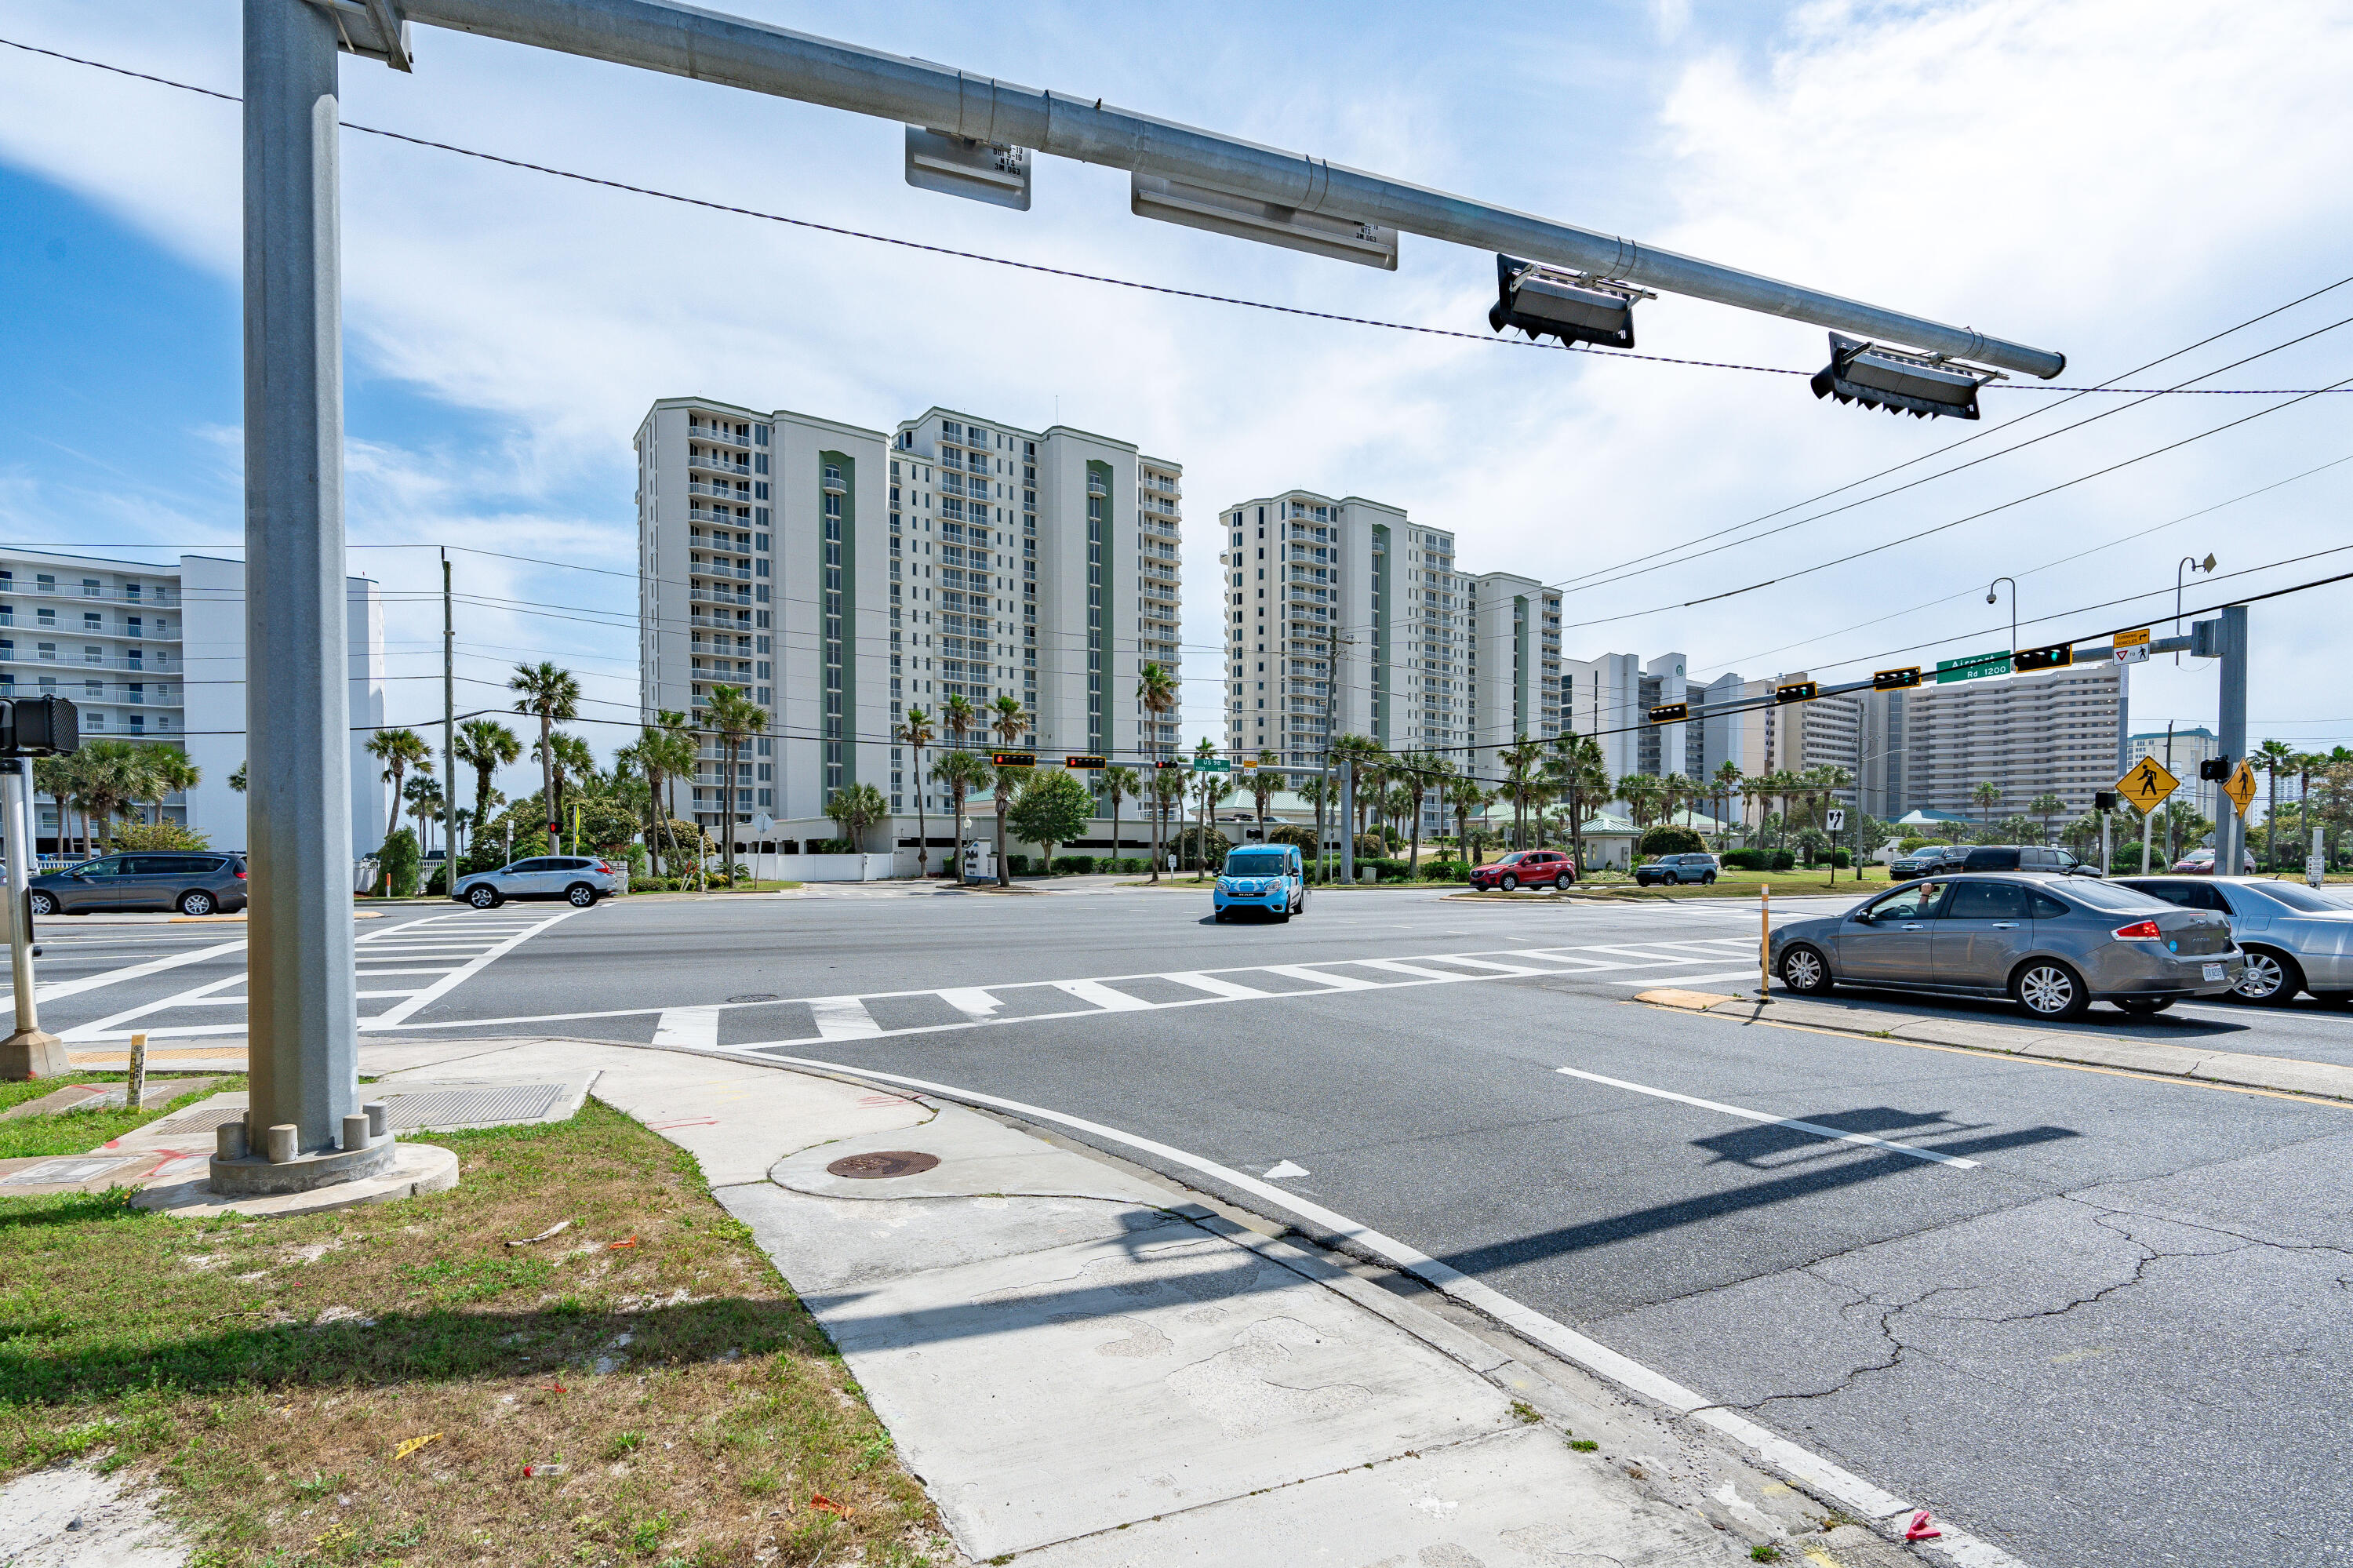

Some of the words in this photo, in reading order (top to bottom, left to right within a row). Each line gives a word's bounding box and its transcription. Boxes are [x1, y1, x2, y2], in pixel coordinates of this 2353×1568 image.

[1000, 157, 1015, 167] NTS
[1967, 670, 1978, 678] Rd
[1984, 666, 2007, 676] 1200
